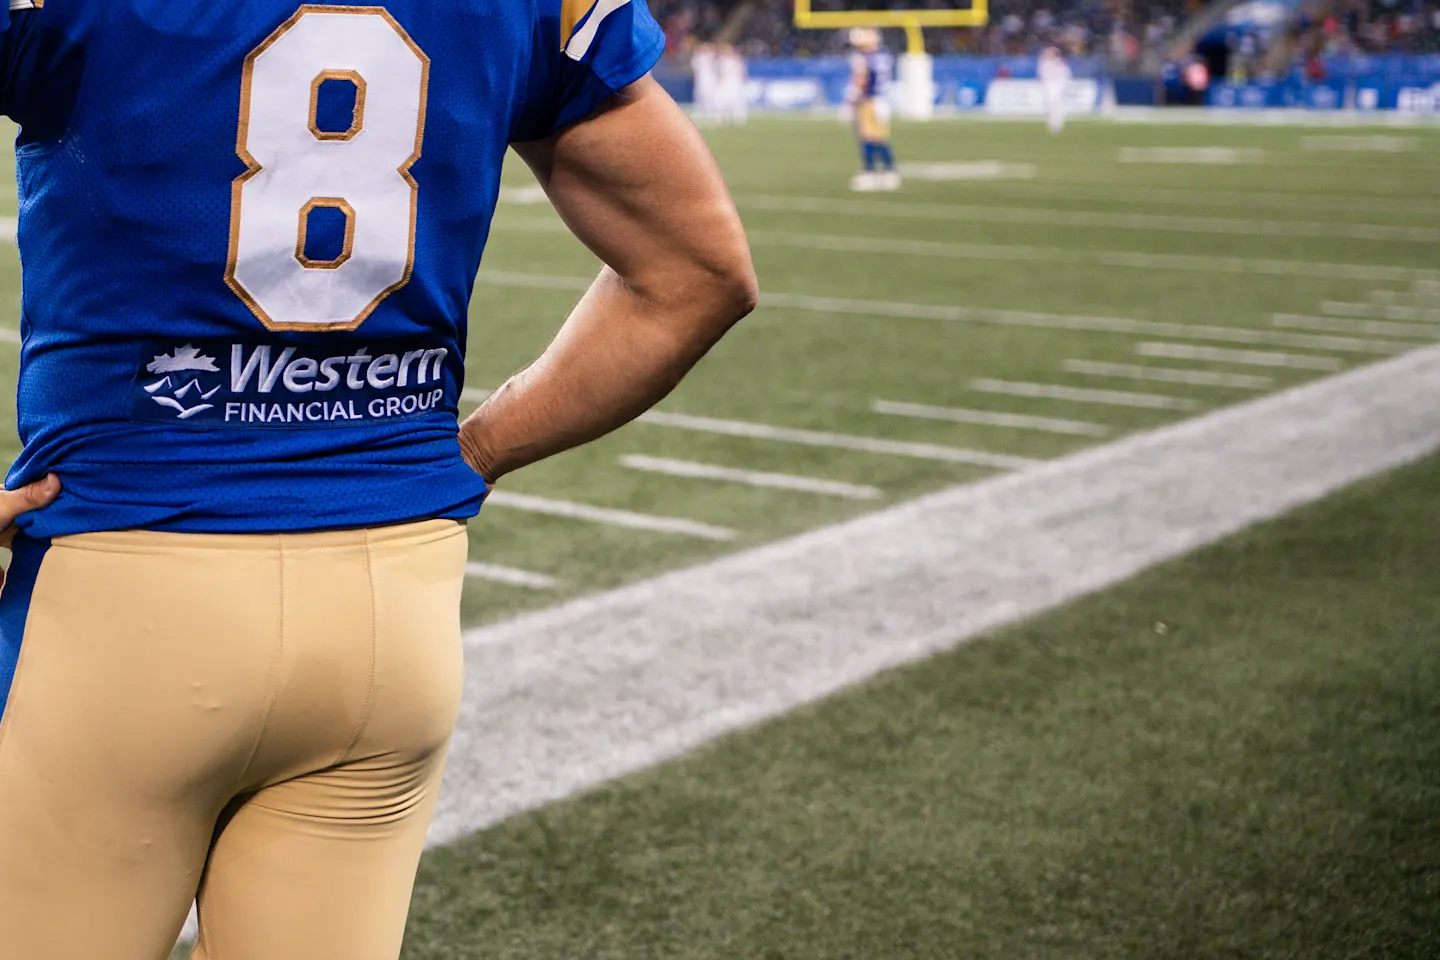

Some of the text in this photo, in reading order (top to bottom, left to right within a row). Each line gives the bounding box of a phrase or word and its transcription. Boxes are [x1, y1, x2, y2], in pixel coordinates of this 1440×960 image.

[223, 3, 431, 333] 8
[230, 343, 449, 394] Western
[224, 388, 444, 424] FINANCIAL GROUP
